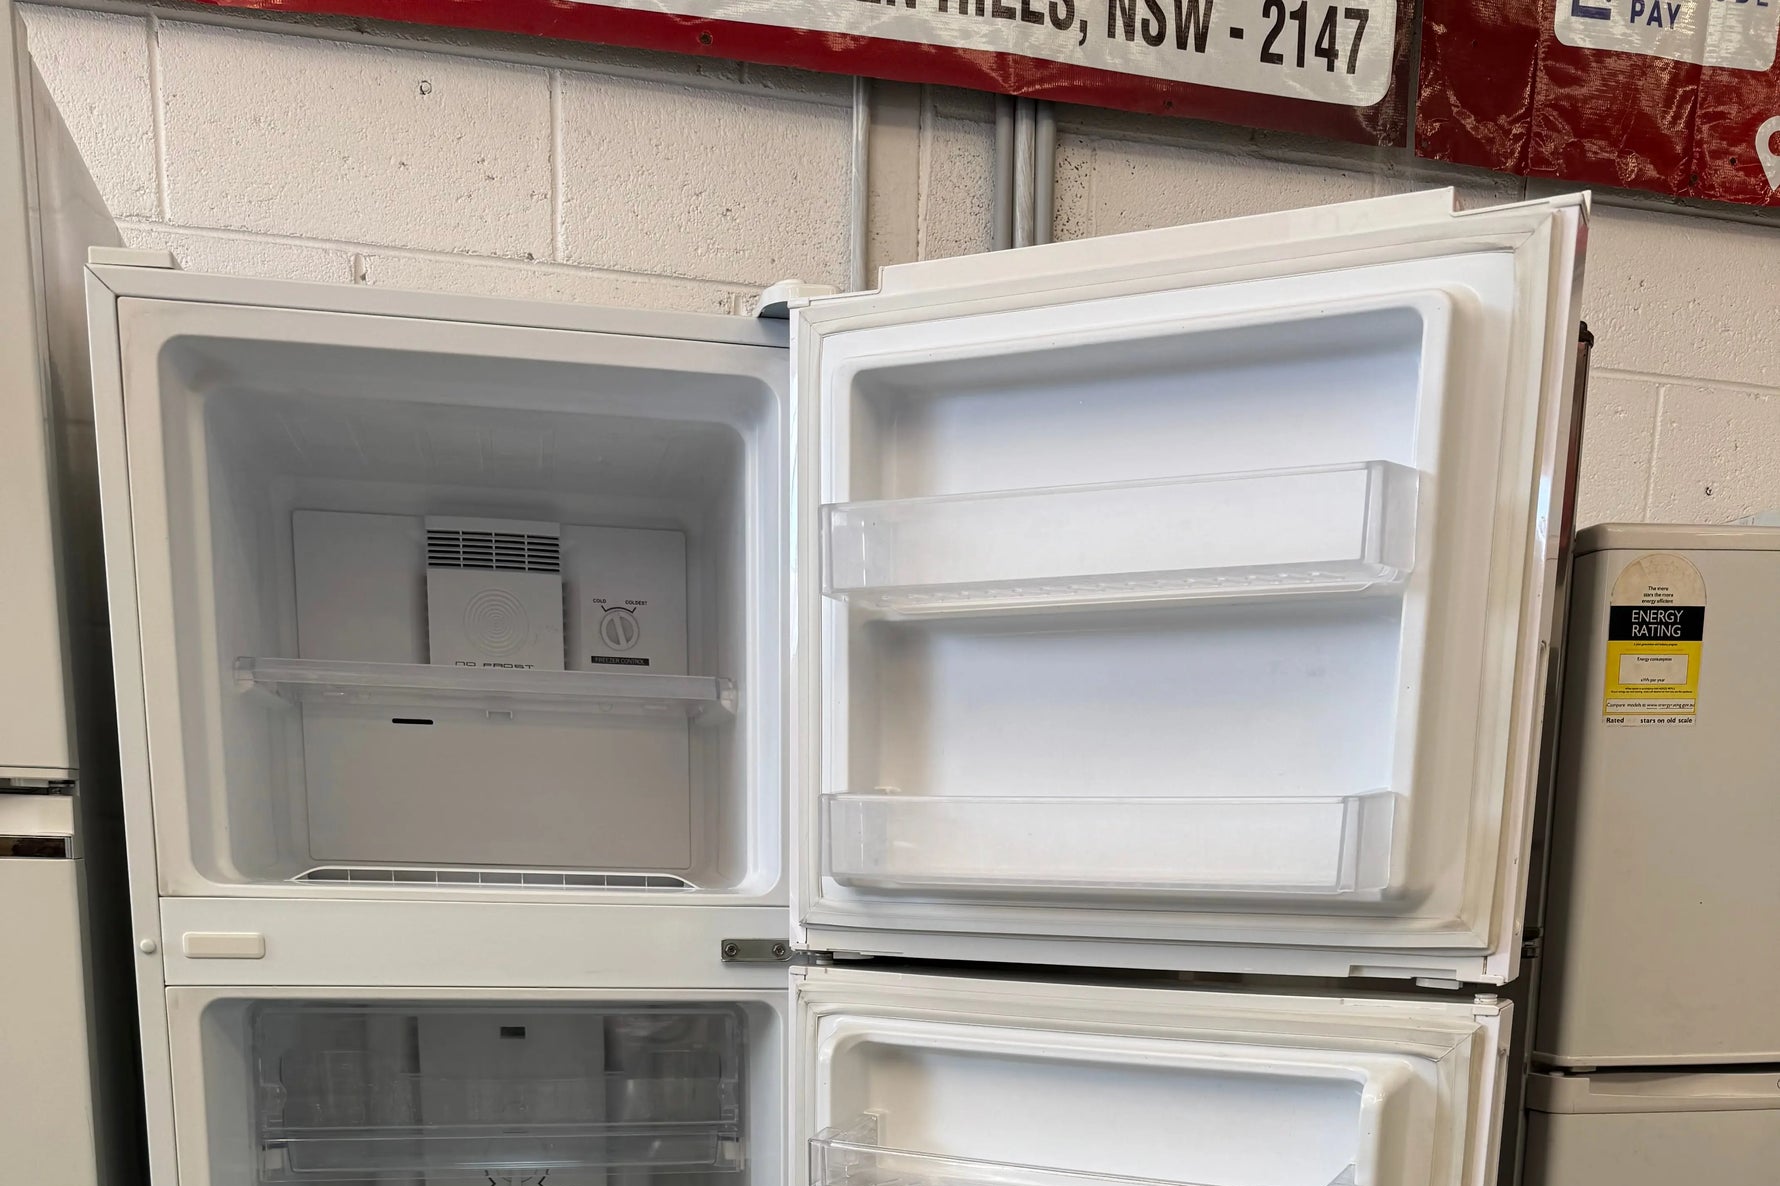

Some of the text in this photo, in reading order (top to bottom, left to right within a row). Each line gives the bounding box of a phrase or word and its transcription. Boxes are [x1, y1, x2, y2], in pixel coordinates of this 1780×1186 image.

[1630, 0, 1682, 30] PAY
[1107, 0, 1213, 54] NSW
[1260, 0, 1370, 75] 2147
[1631, 609, 1684, 623] ENERGY
[1631, 624, 1682, 638] RATING
[594, 656, 620, 664] FREEZER
